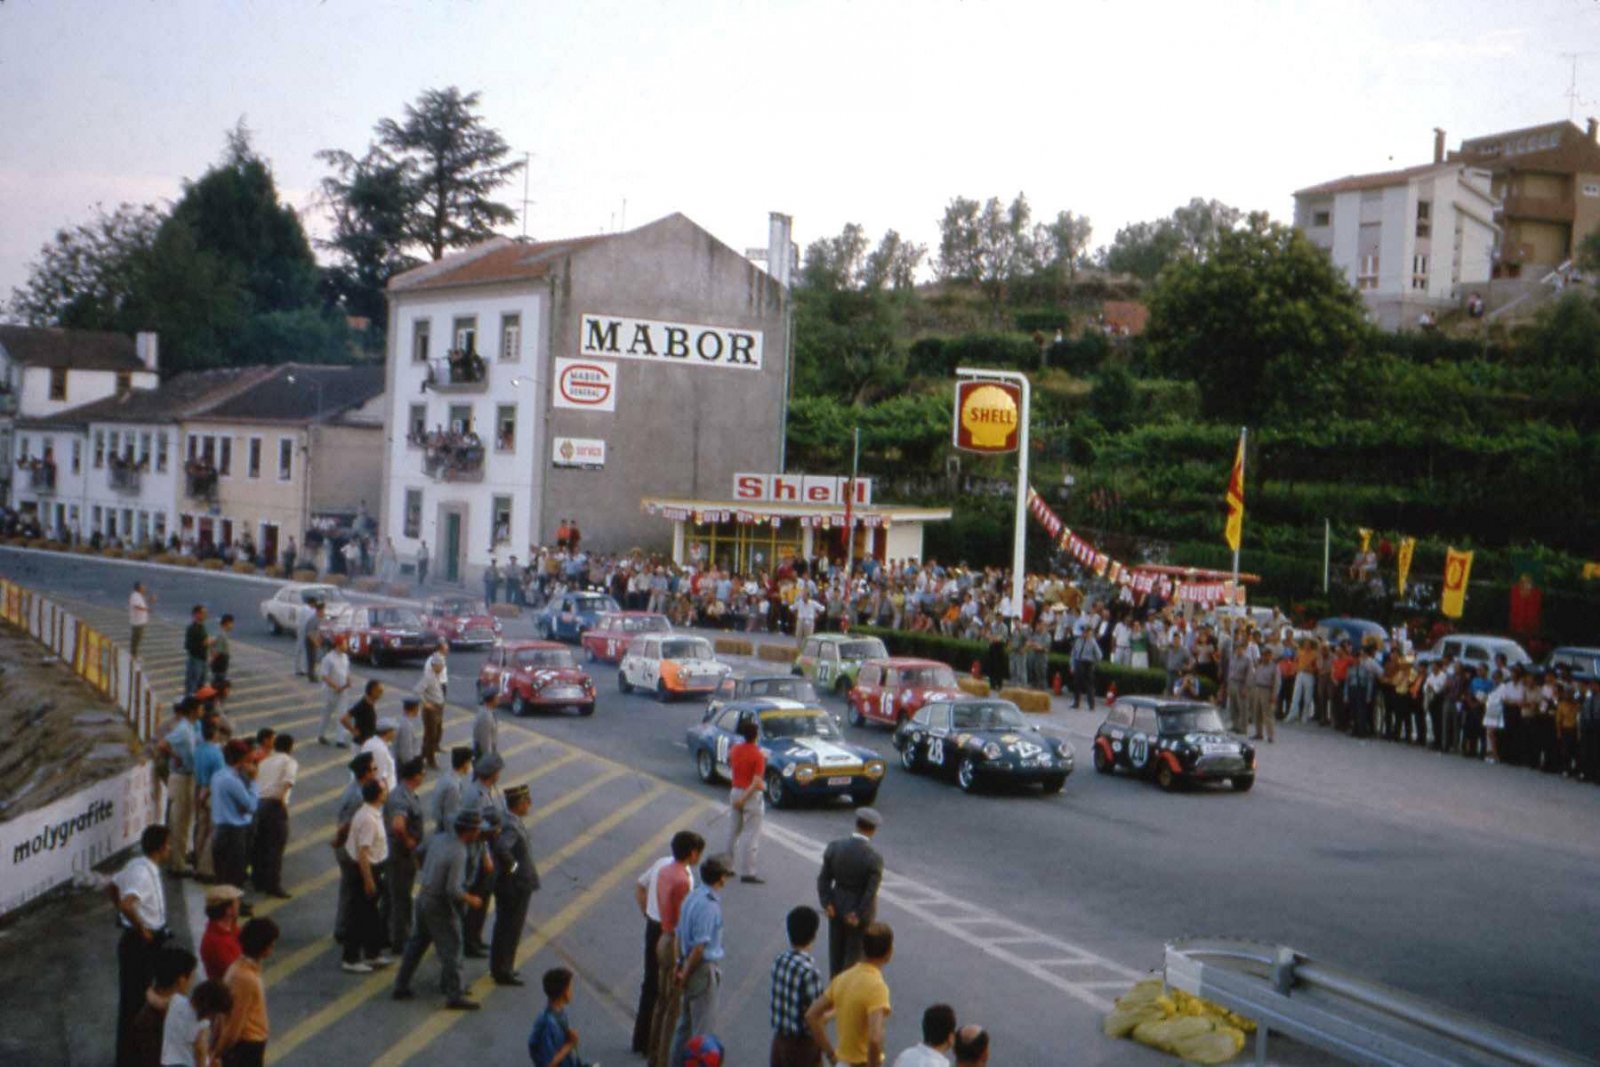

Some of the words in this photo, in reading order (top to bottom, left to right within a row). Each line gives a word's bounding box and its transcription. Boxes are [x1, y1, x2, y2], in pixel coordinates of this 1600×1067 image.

[585, 318, 758, 366] MABOR
[970, 407, 1013, 424] SHELL
[737, 477, 865, 503] Shell
[880, 692, 894, 716] 16
[927, 737, 945, 766] 28
[1132, 737, 1146, 758] 20
[12, 800, 113, 864] molygrafite
